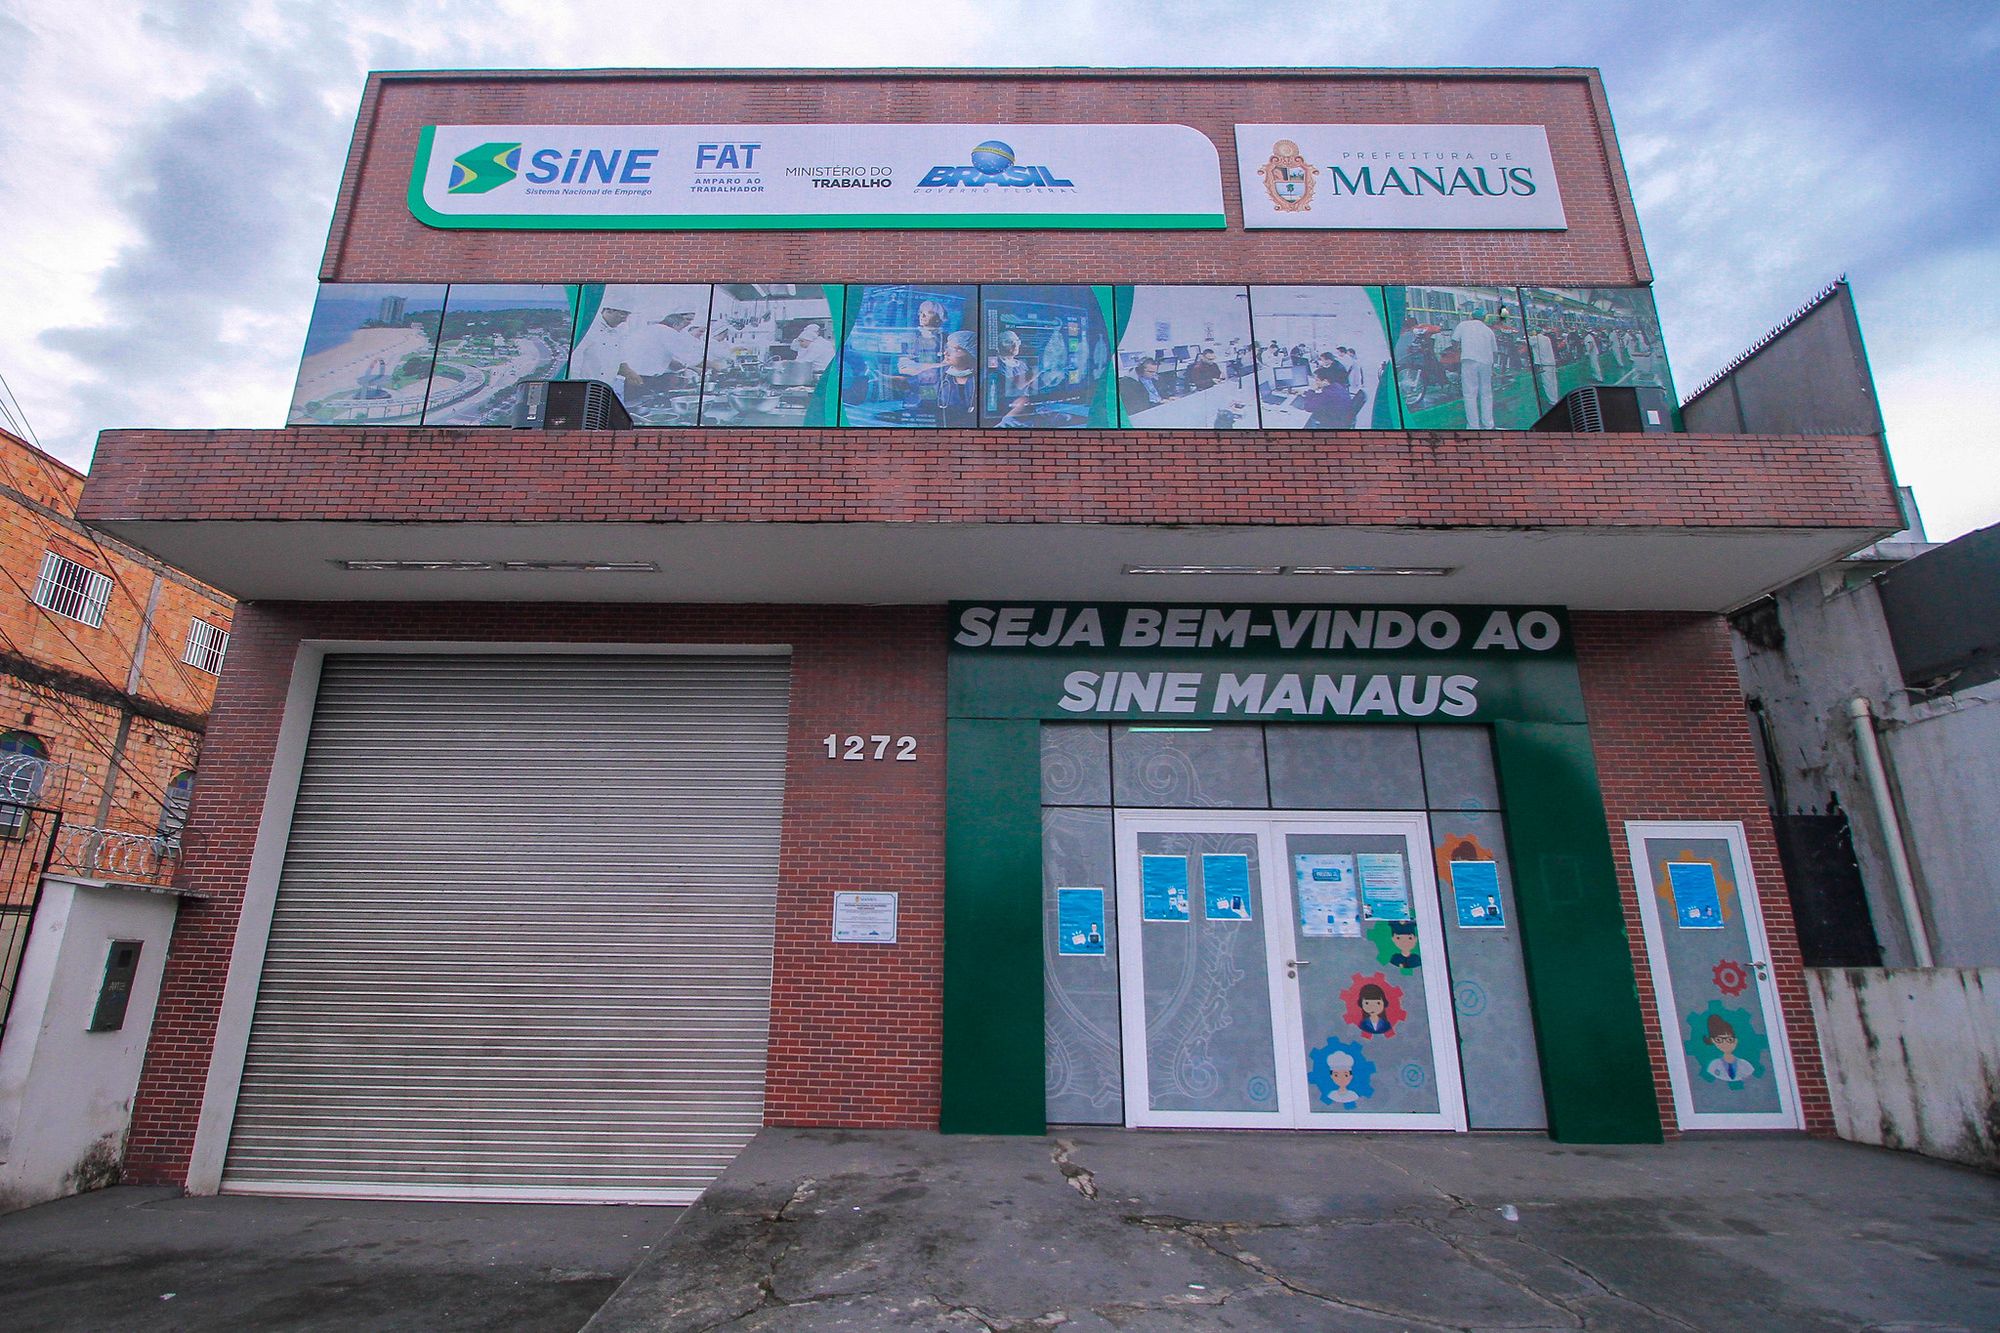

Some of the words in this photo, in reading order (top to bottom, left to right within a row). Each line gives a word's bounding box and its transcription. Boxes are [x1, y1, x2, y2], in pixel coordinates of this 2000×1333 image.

[695, 144, 761, 169] FAT
[1342, 152, 1475, 161] PREFEITURA
[1489, 152, 1513, 161] DE
[785, 165, 866, 177] MINISTÉRIO
[870, 166, 892, 177] DO
[916, 165, 1075, 187] BRASIL
[1327, 166, 1537, 197] MANAUS
[614, 188, 653, 197] Emprego
[812, 178, 892, 188] TRABALHO
[954, 606, 1105, 648] SEJA
[1119, 608, 1462, 650] BEM-VINDO
[1472, 609, 1561, 651] AO
[1057, 670, 1203, 714] SINE
[1212, 673, 1480, 718] MANAUS
[823, 733, 918, 761] 1272
